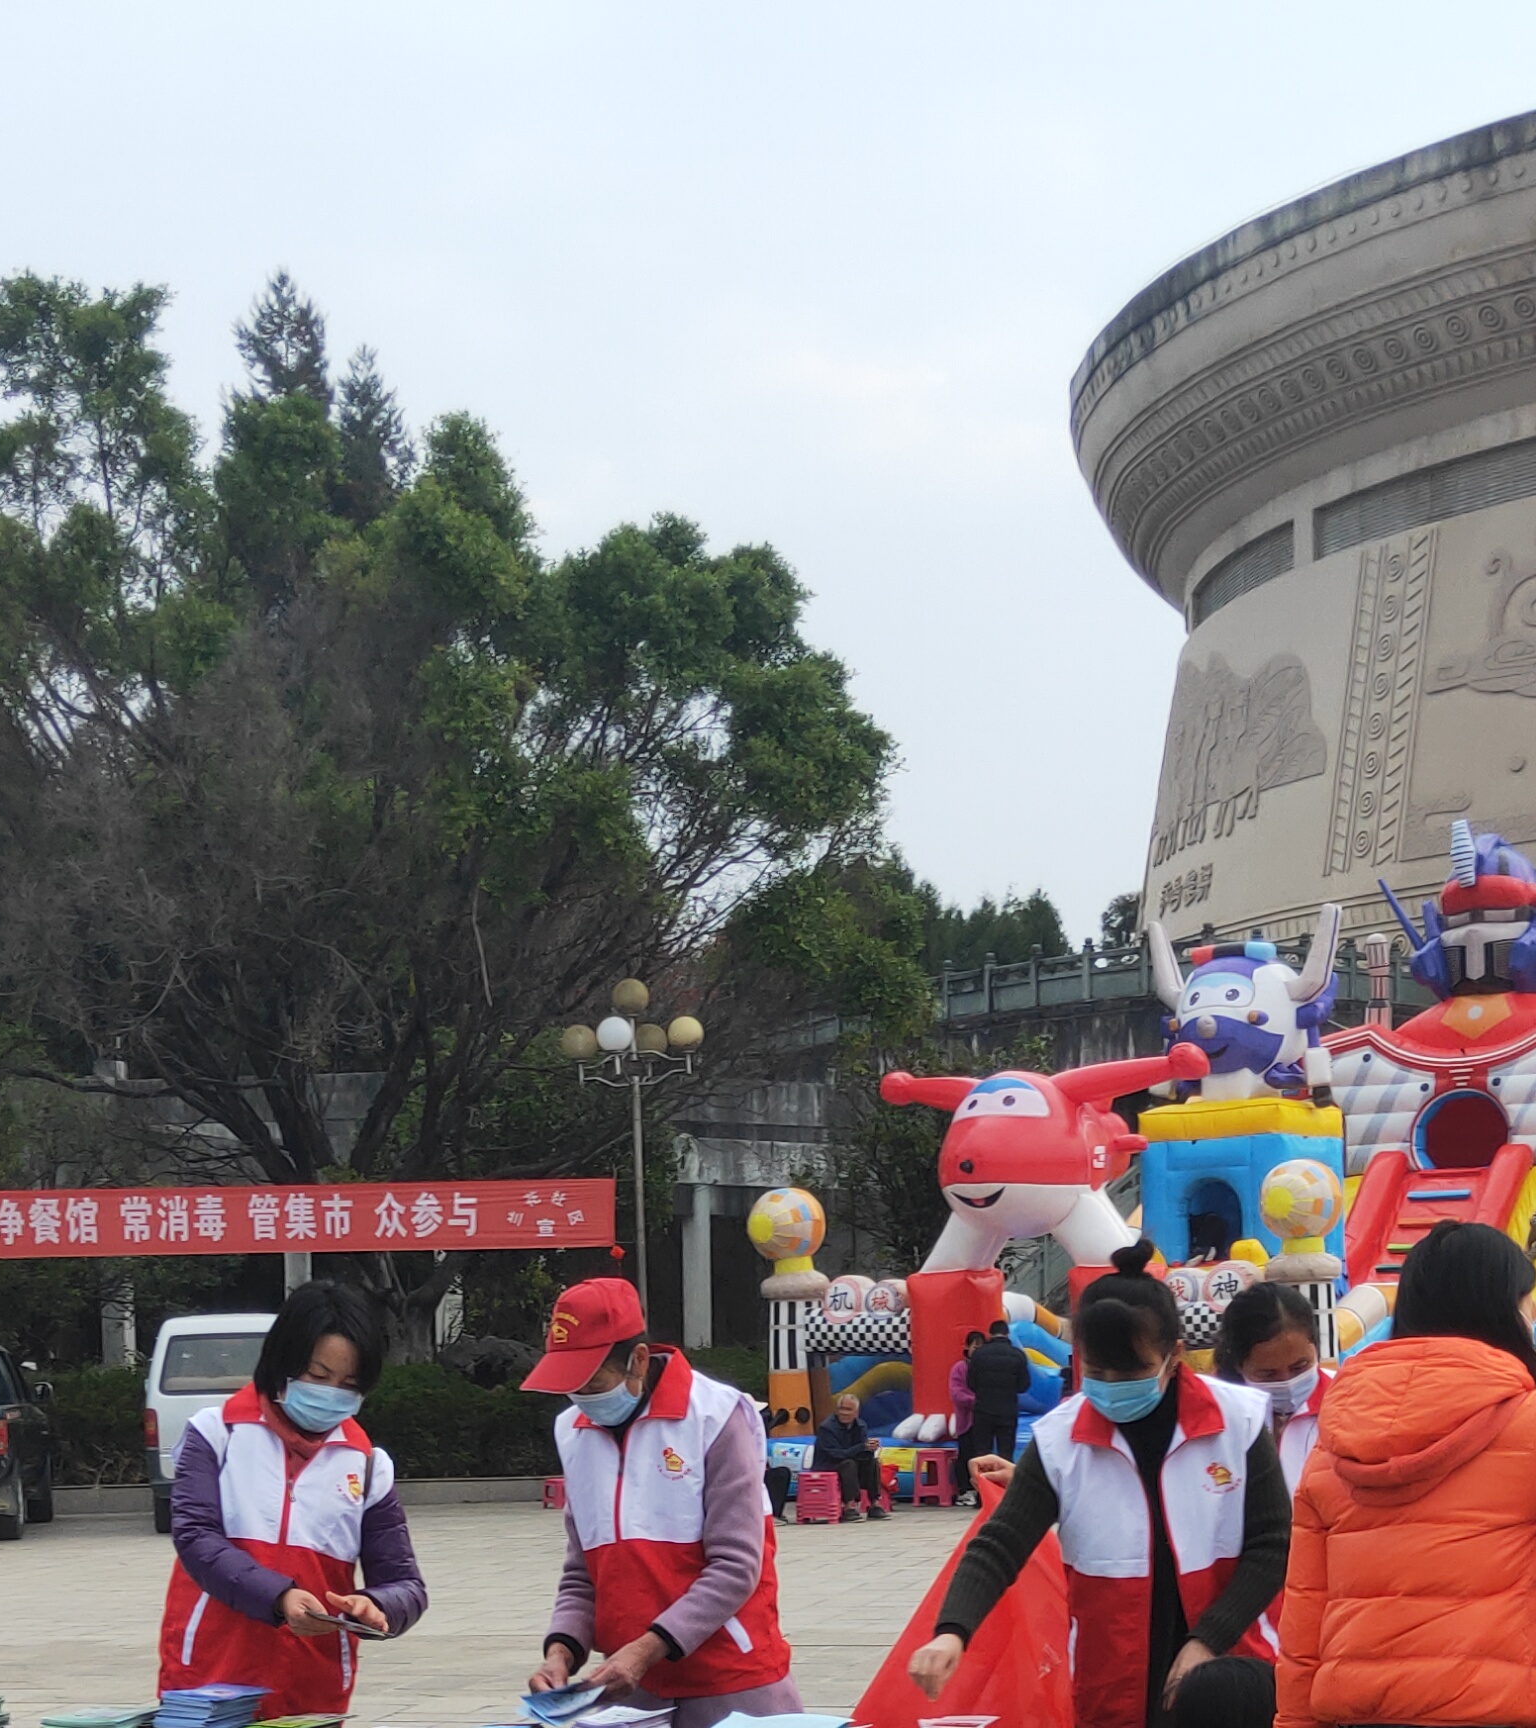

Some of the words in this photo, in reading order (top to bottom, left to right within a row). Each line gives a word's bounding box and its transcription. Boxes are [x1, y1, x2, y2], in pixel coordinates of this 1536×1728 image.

[119, 1196, 226, 1244] 常消毒
[247, 1193, 353, 1241] 管集市
[374, 1189, 479, 1238] 众参与
